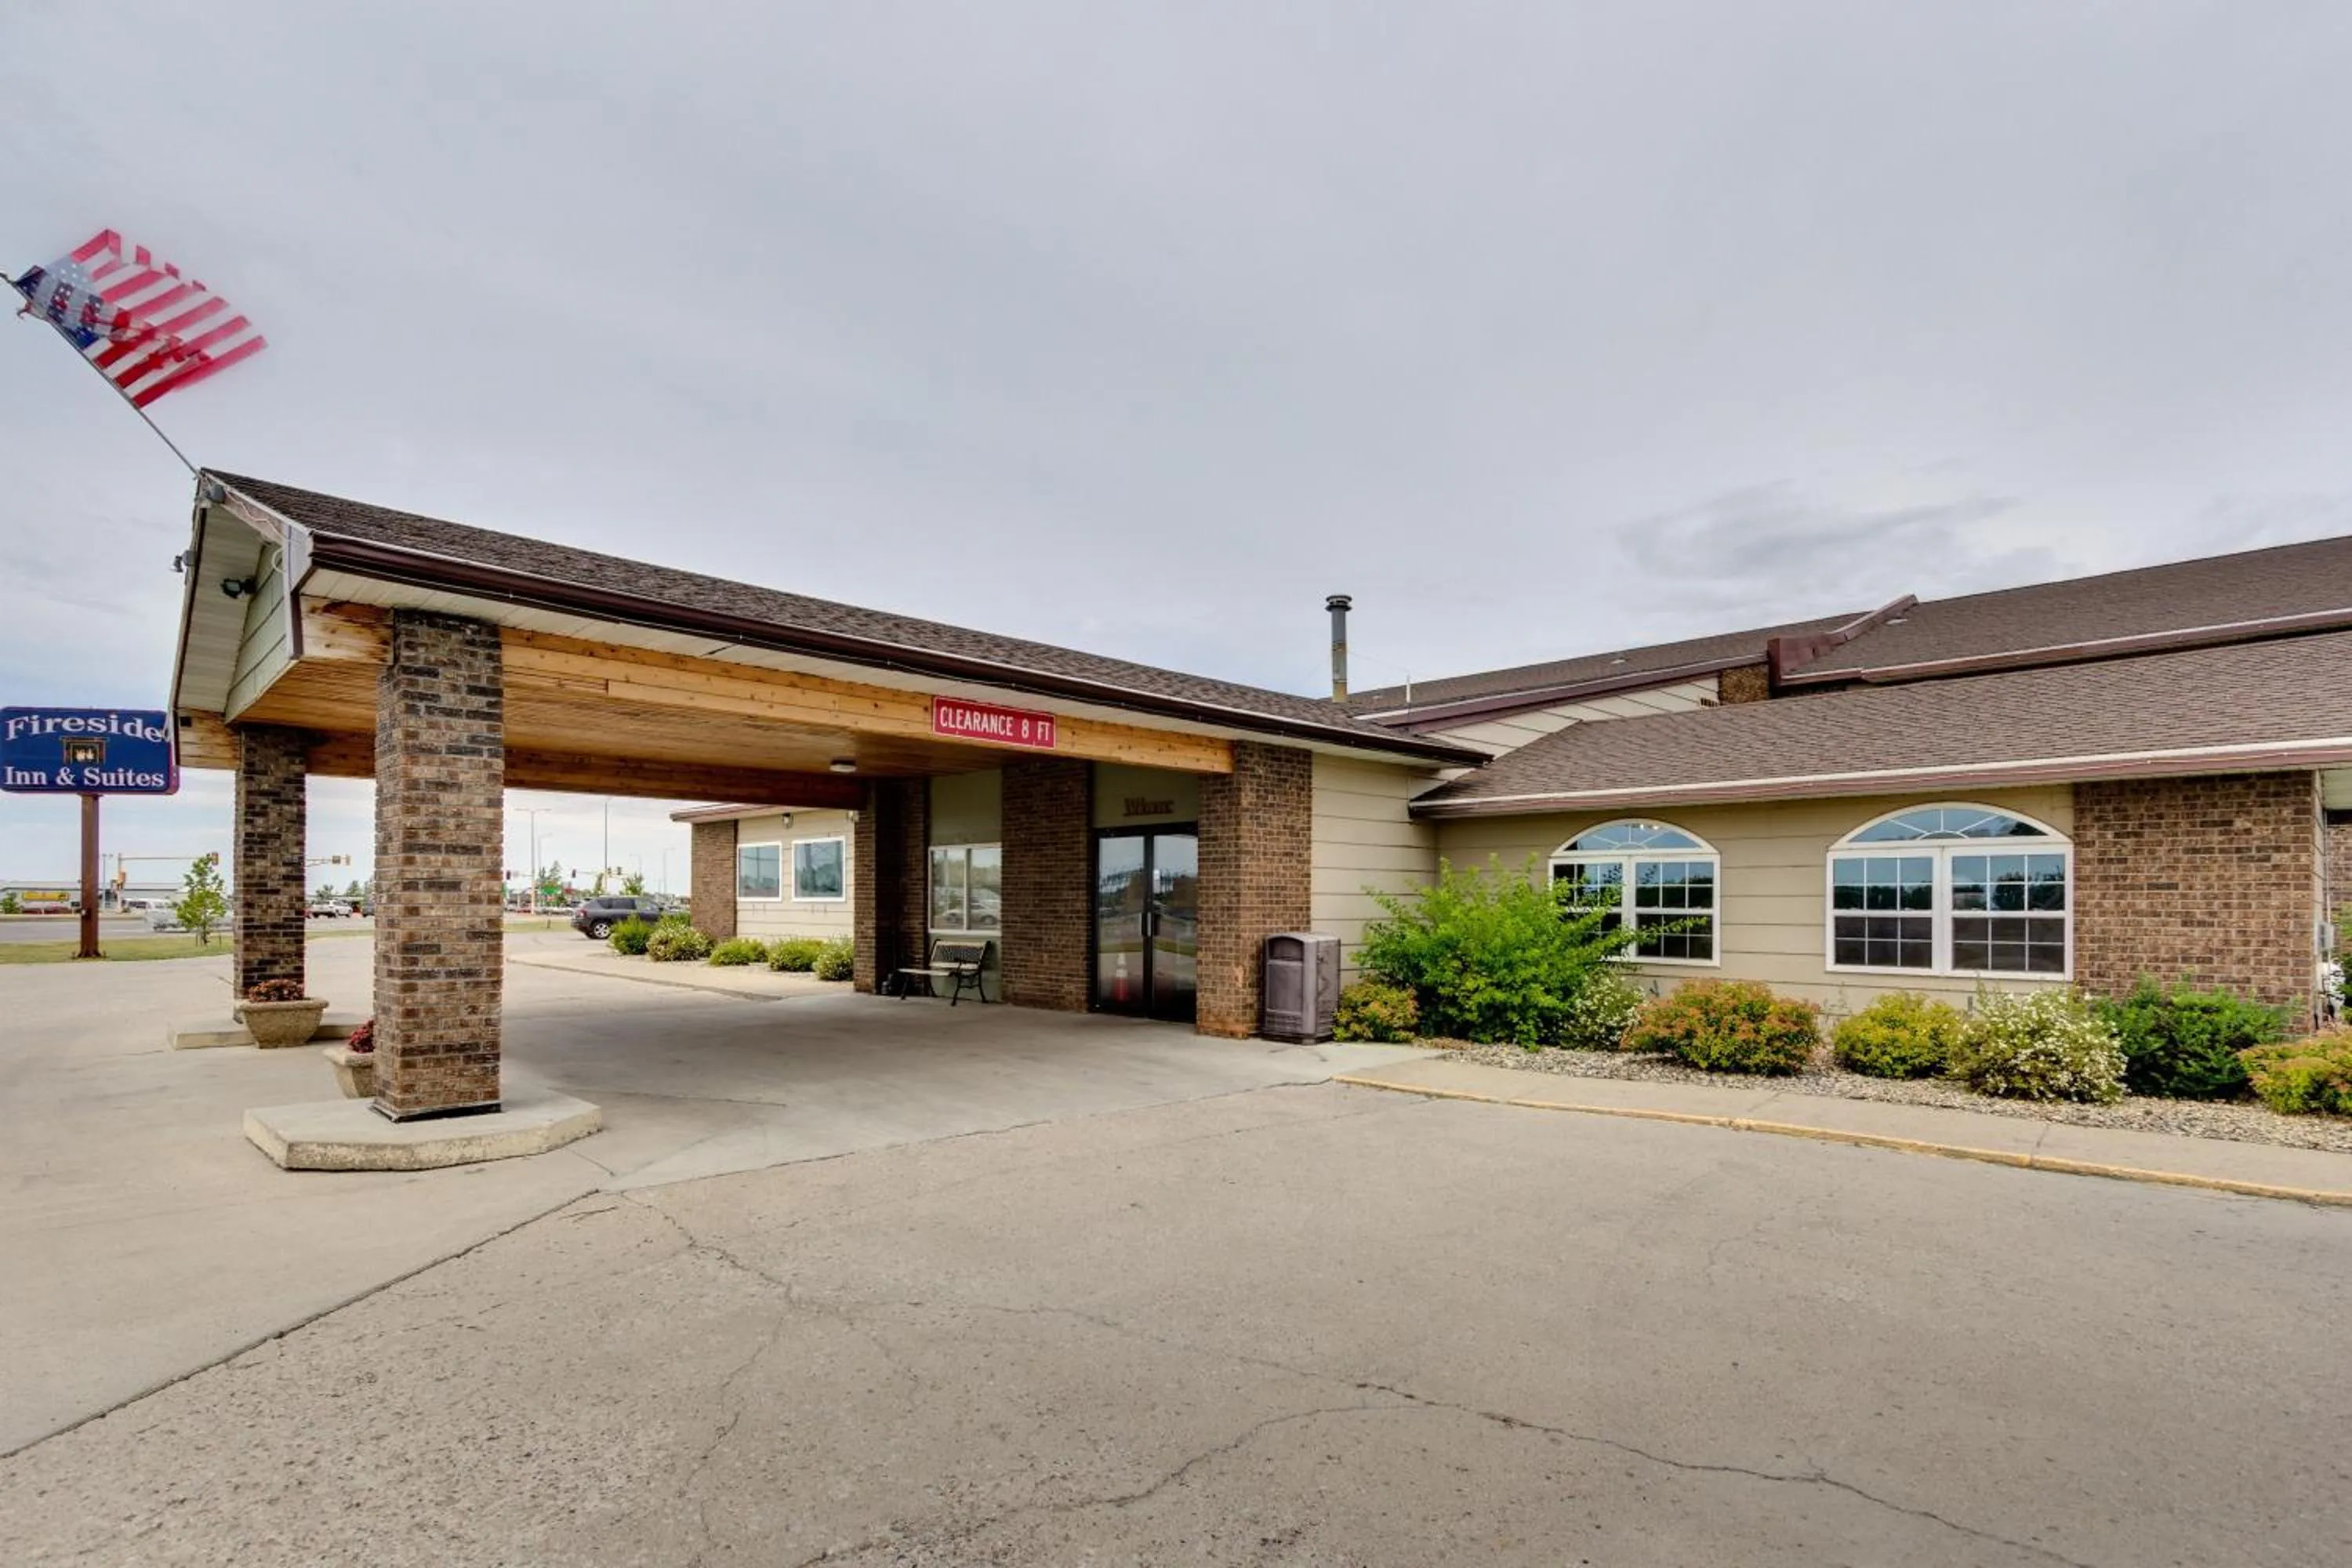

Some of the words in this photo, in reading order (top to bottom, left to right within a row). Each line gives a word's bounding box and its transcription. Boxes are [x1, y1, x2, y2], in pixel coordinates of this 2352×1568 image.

[5, 714, 163, 742] Fireside
[940, 706, 1014, 736] CLEARANCE
[1022, 718, 1029, 739] 8
[1037, 720, 1051, 741] FT
[5, 766, 48, 785] Inn
[56, 766, 76, 786] &
[83, 766, 165, 787] Suites
